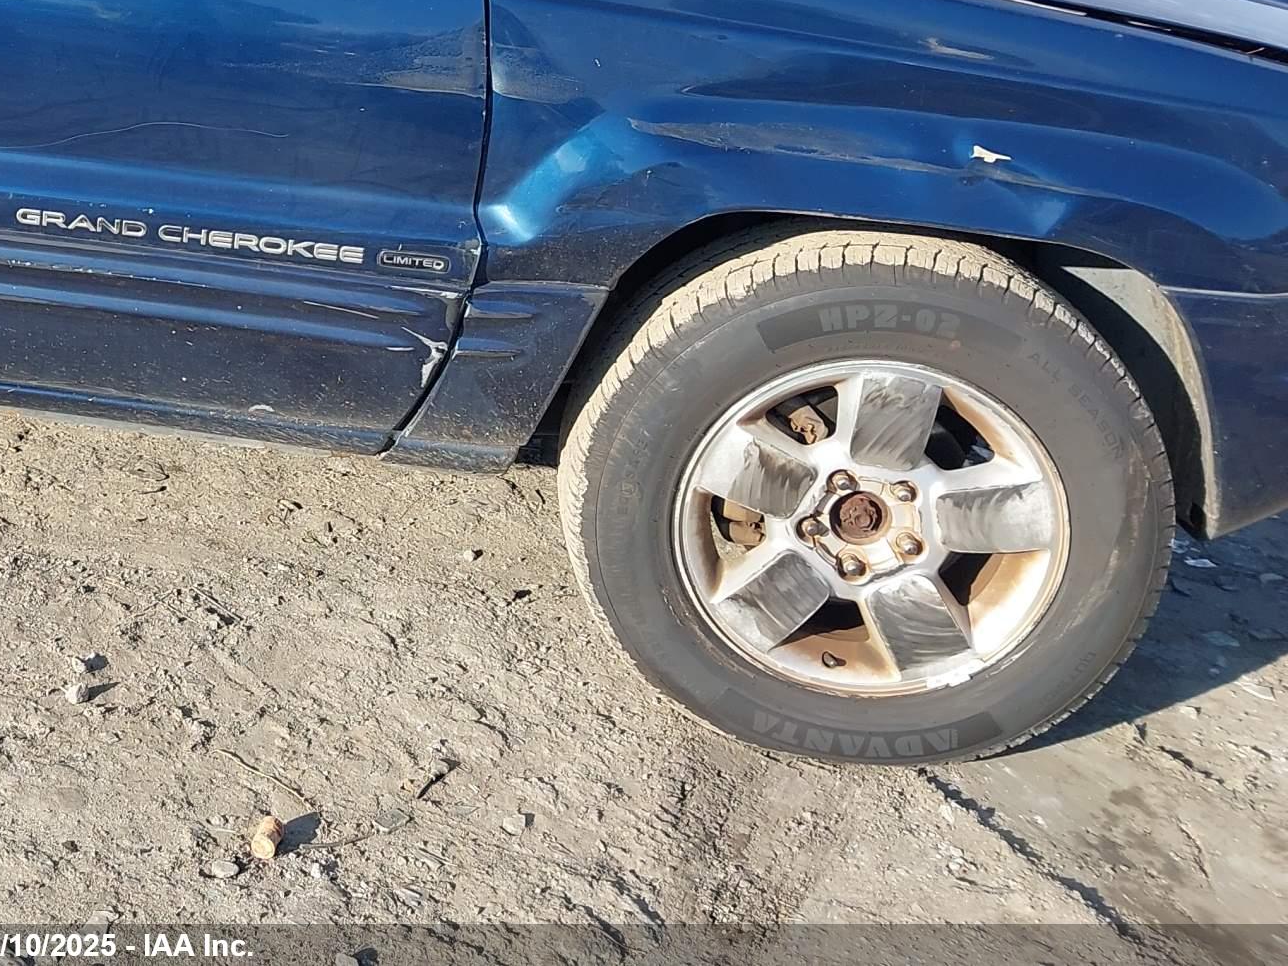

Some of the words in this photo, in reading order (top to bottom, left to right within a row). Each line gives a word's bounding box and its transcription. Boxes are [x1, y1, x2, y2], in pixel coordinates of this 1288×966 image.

[15, 207, 147, 238] GRAND
[157, 224, 365, 263] CHEROKEE
[383, 254, 444, 270] LIMITED
[753, 710, 959, 758] ADVANTA
